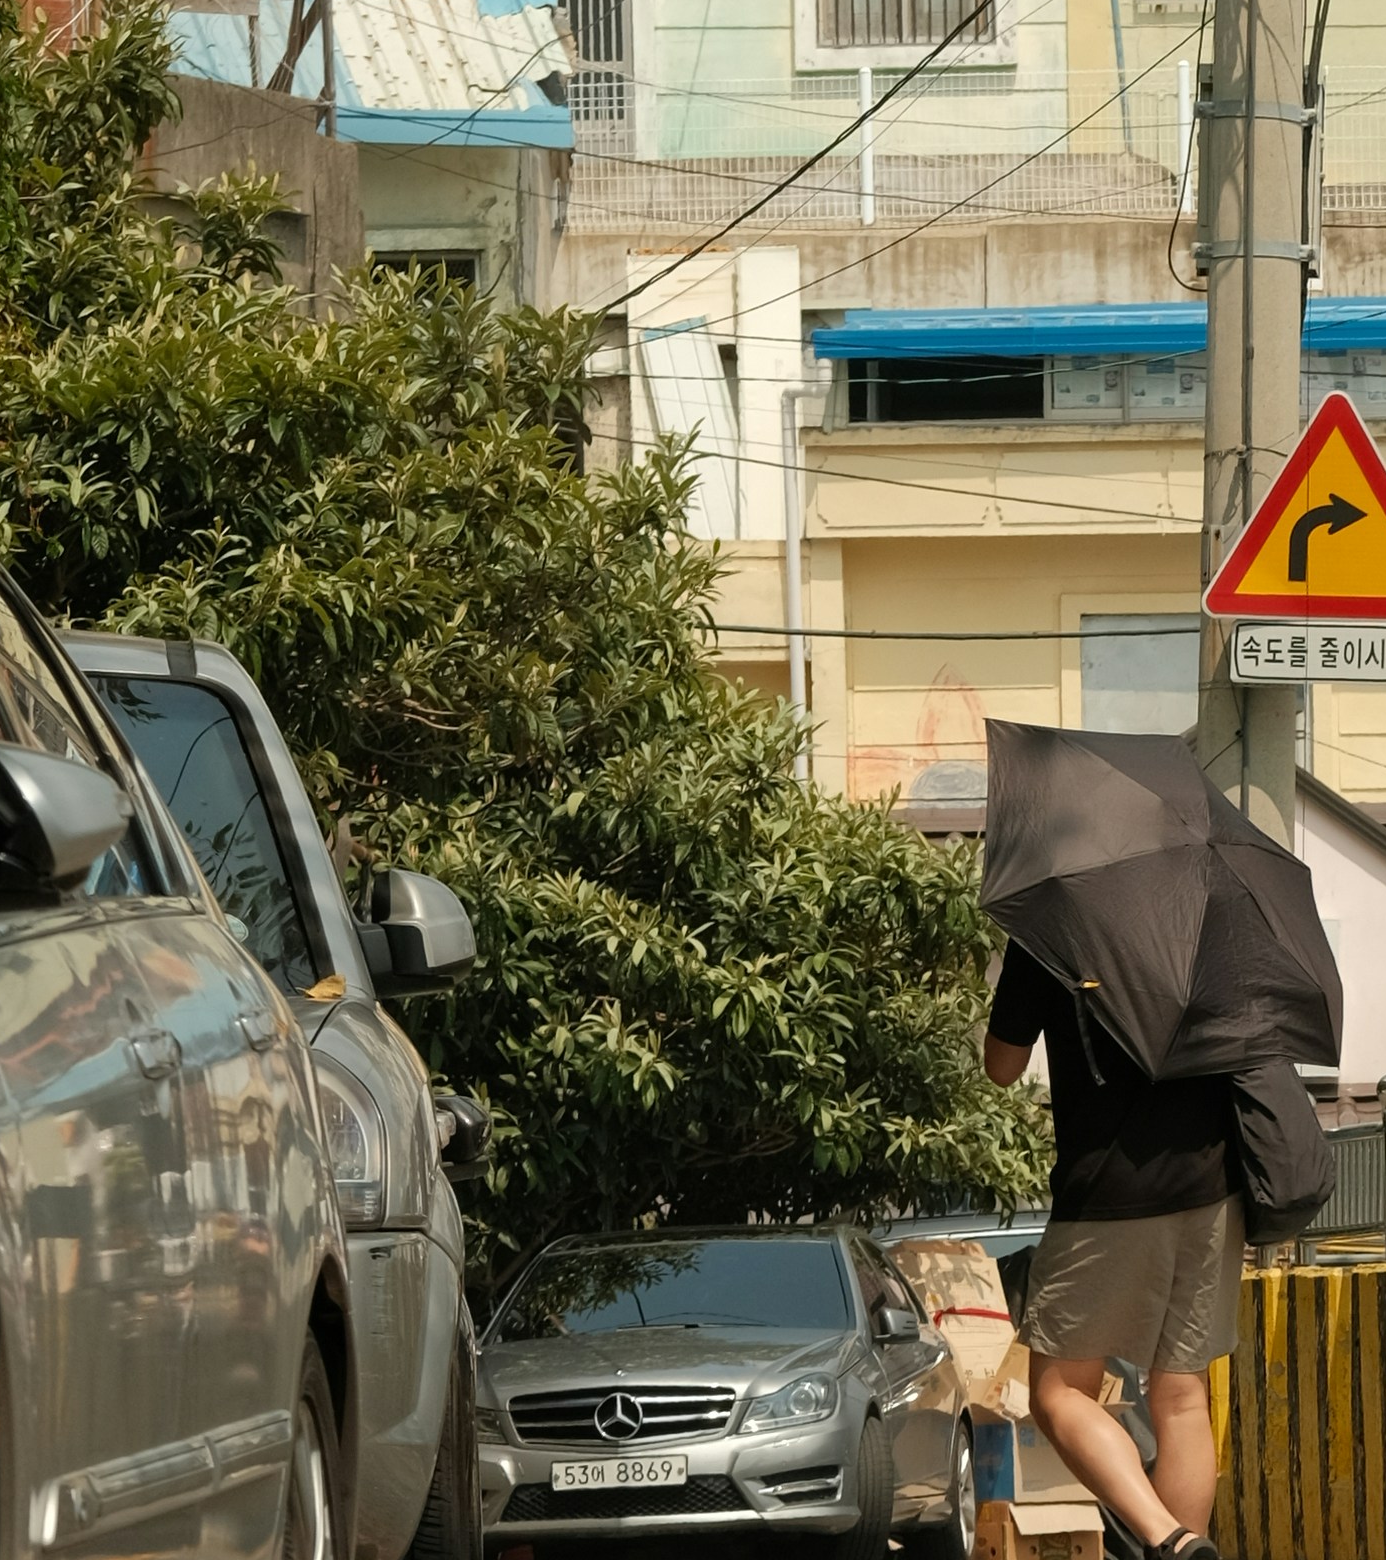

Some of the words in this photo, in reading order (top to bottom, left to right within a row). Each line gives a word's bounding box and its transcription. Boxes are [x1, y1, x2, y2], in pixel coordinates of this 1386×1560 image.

[1241, 635, 1308, 668] 속도를
[564, 1464, 605, 1485] 53어
[616, 1460, 673, 1483] 8869
